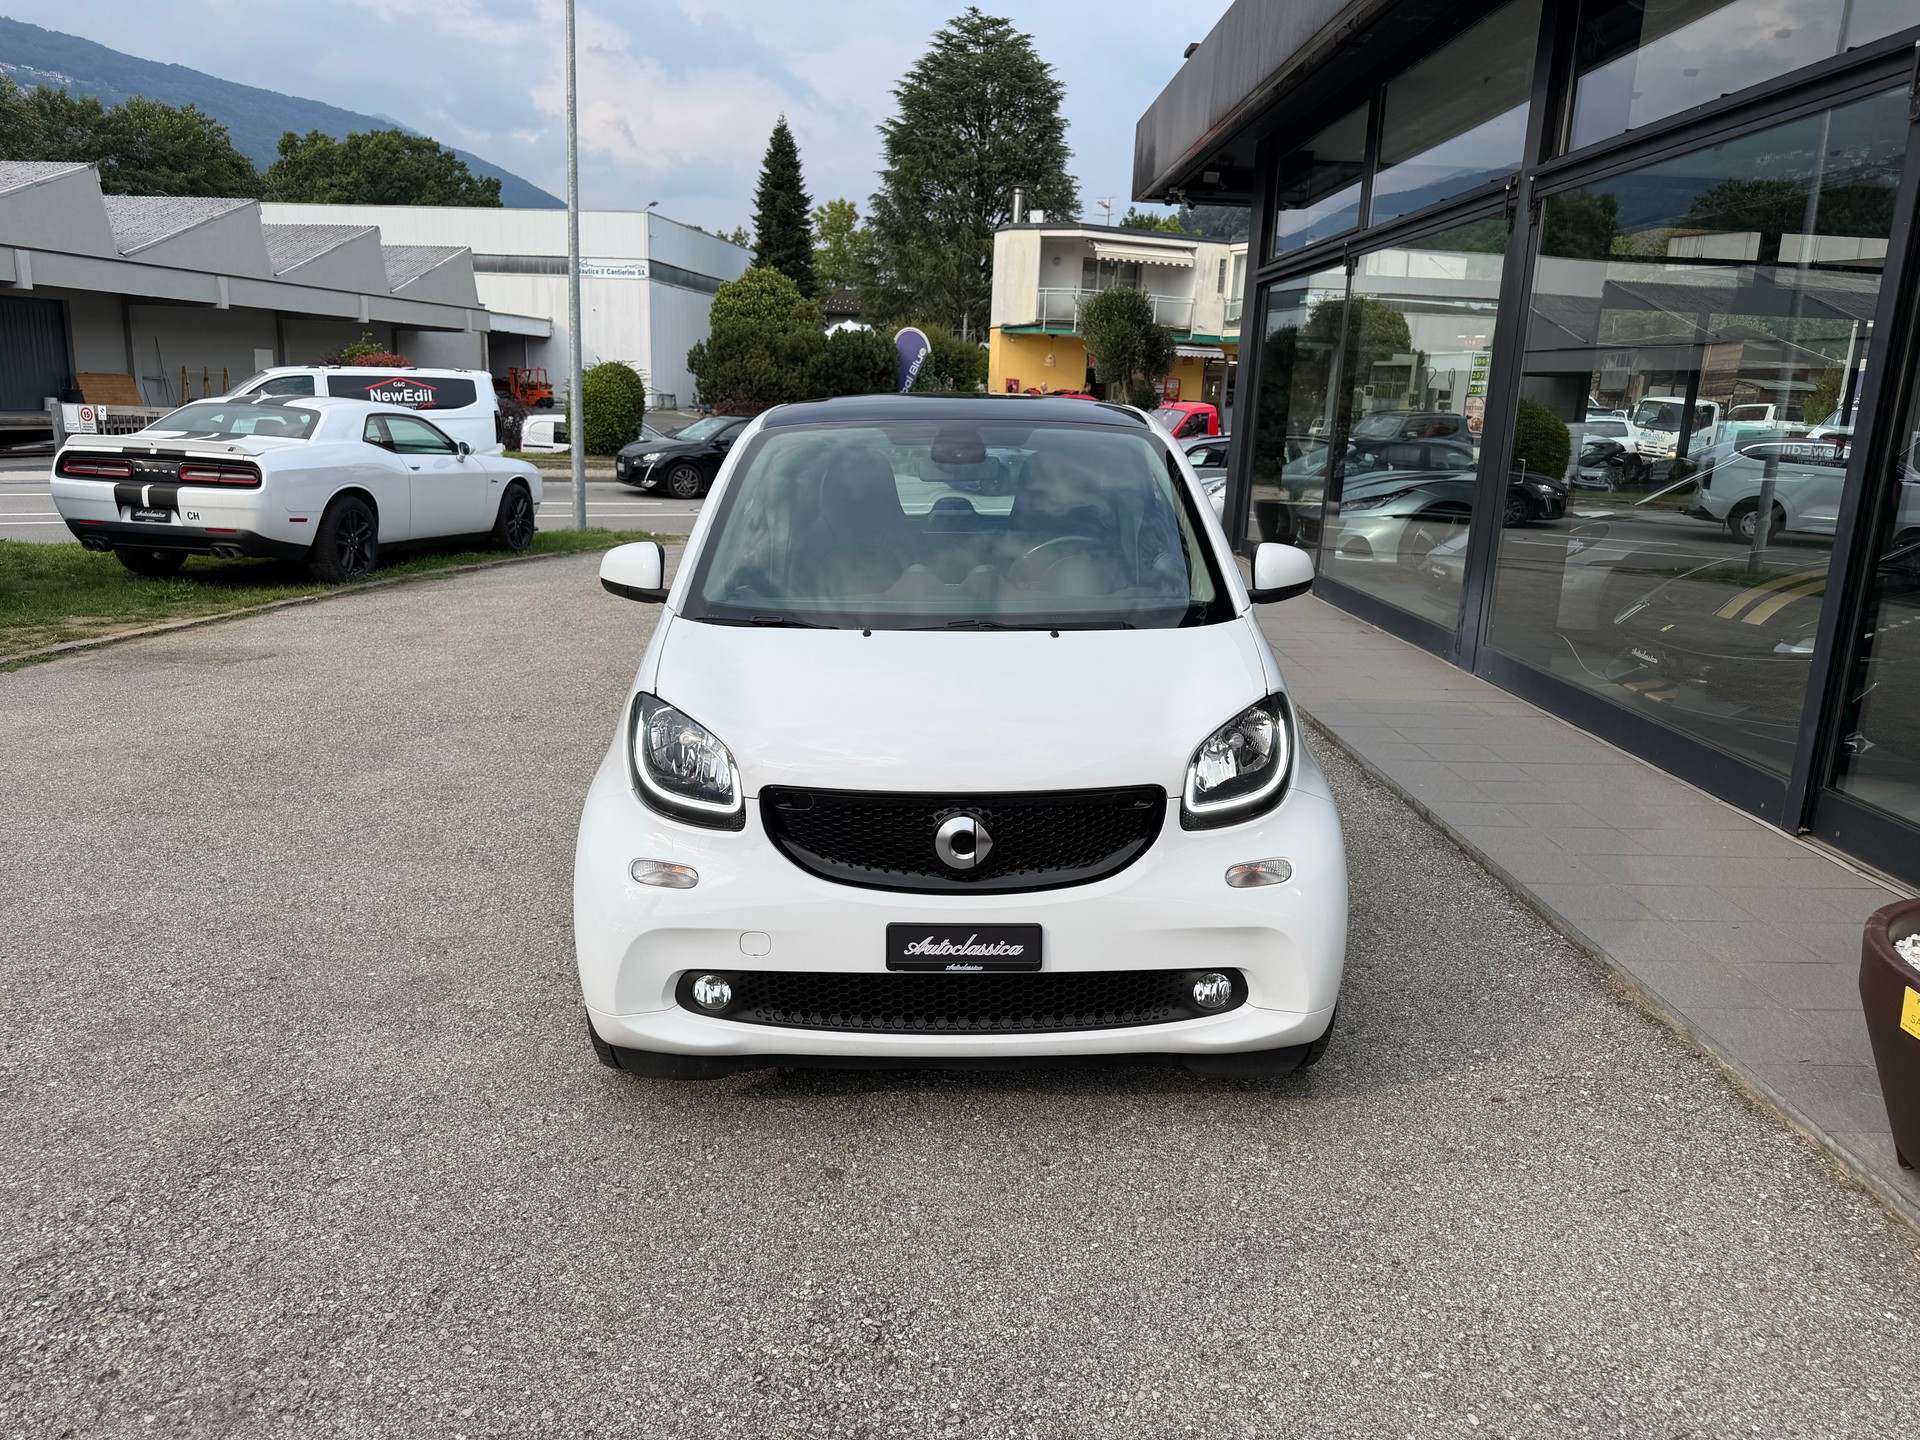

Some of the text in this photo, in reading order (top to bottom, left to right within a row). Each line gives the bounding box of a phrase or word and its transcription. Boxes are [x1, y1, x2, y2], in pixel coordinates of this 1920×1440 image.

[606, 268, 636, 276] Cantierino
[909, 347, 927, 375] Blue
[369, 388, 433, 402] NewEdil
[83, 411, 91, 419] 15
[186, 511, 200, 521] CH
[903, 933, 1025, 956] Autoclassica
